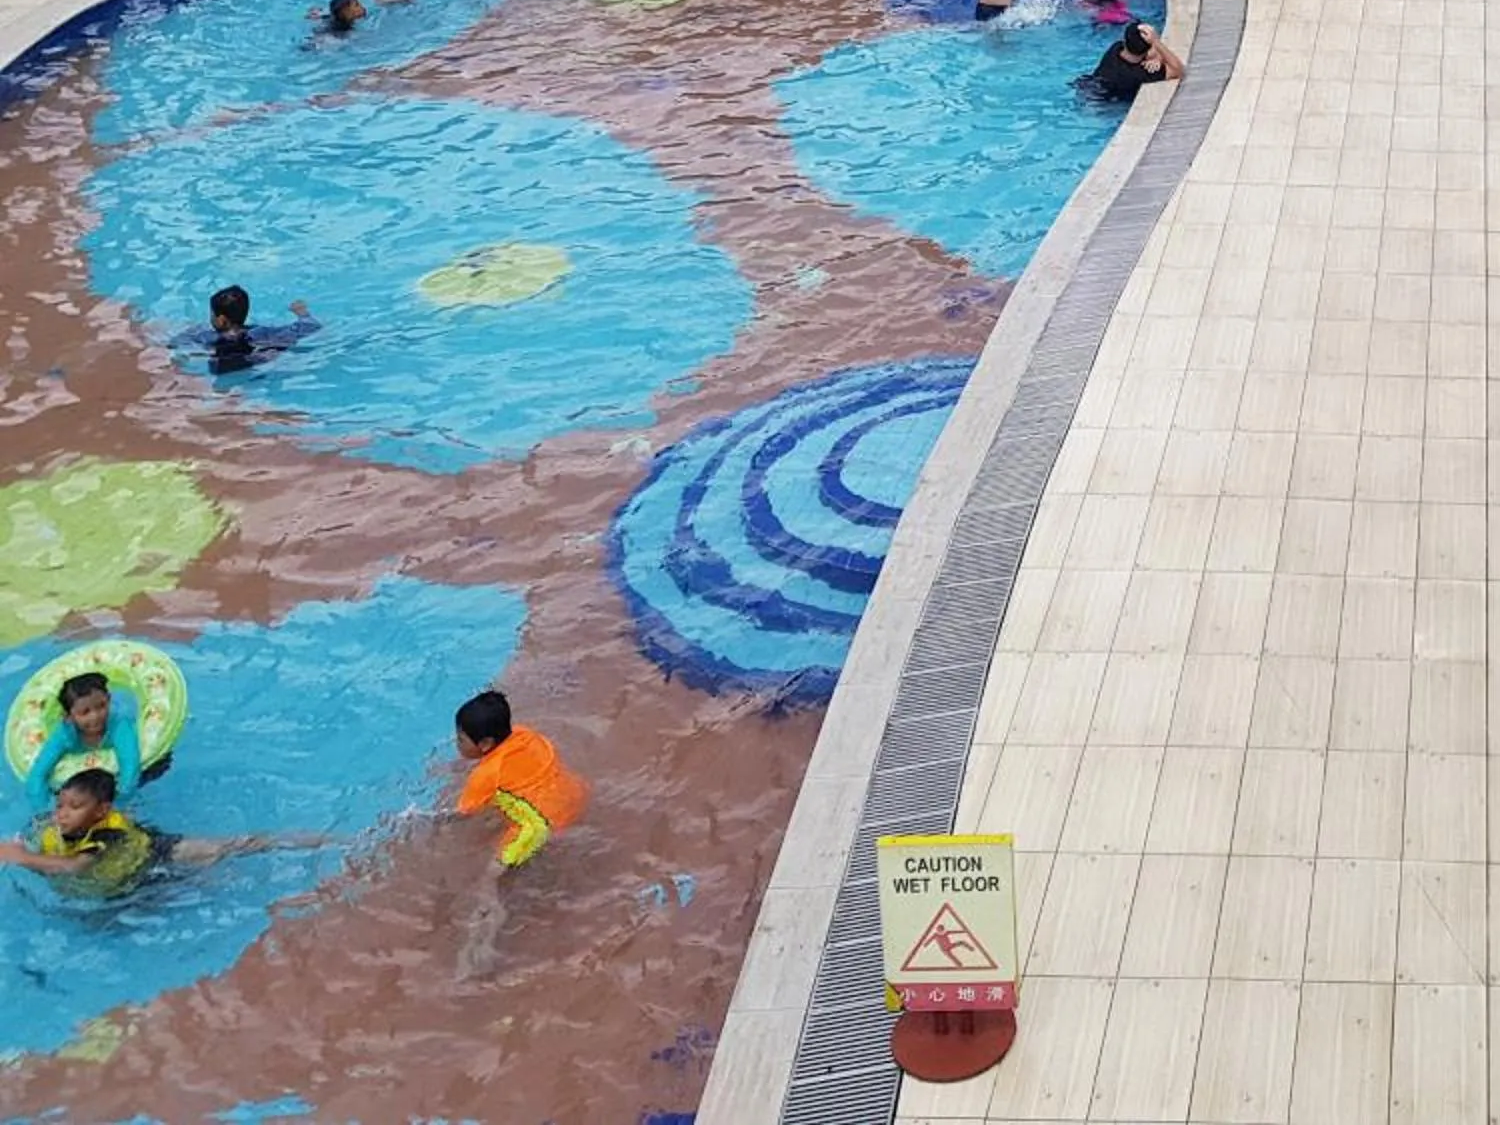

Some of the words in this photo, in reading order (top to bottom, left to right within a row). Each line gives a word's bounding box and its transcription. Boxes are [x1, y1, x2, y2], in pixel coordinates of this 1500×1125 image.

[904, 856, 983, 873] CAUTION
[893, 878, 931, 894] WET
[941, 876, 1000, 893] FLOOR
